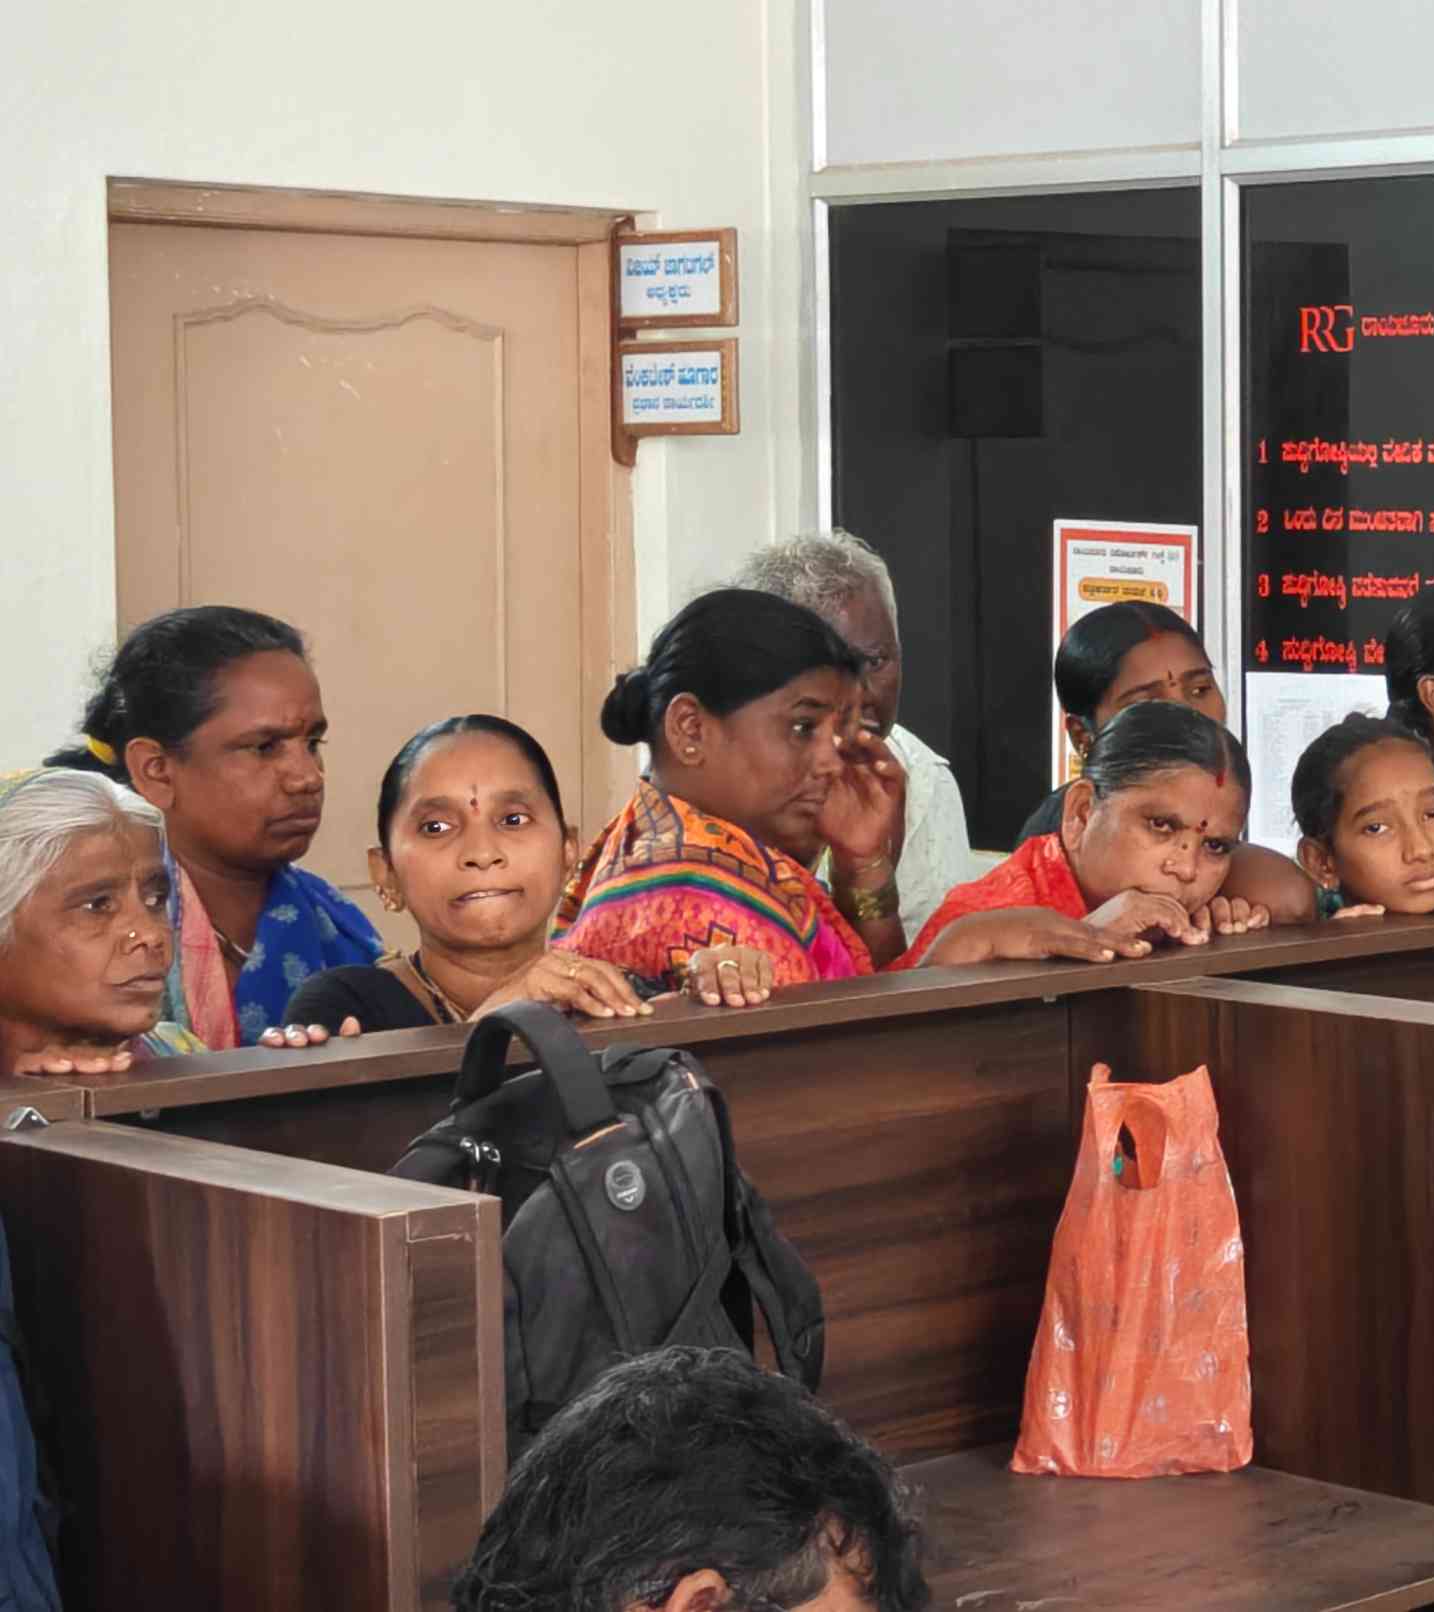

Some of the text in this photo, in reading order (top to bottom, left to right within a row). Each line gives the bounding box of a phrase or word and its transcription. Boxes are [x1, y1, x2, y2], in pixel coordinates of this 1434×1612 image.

[1298, 304, 1357, 353] RRG
[1257, 439, 1268, 464] 1
[1256, 508, 1270, 534] 2
[1257, 573, 1271, 599] 3
